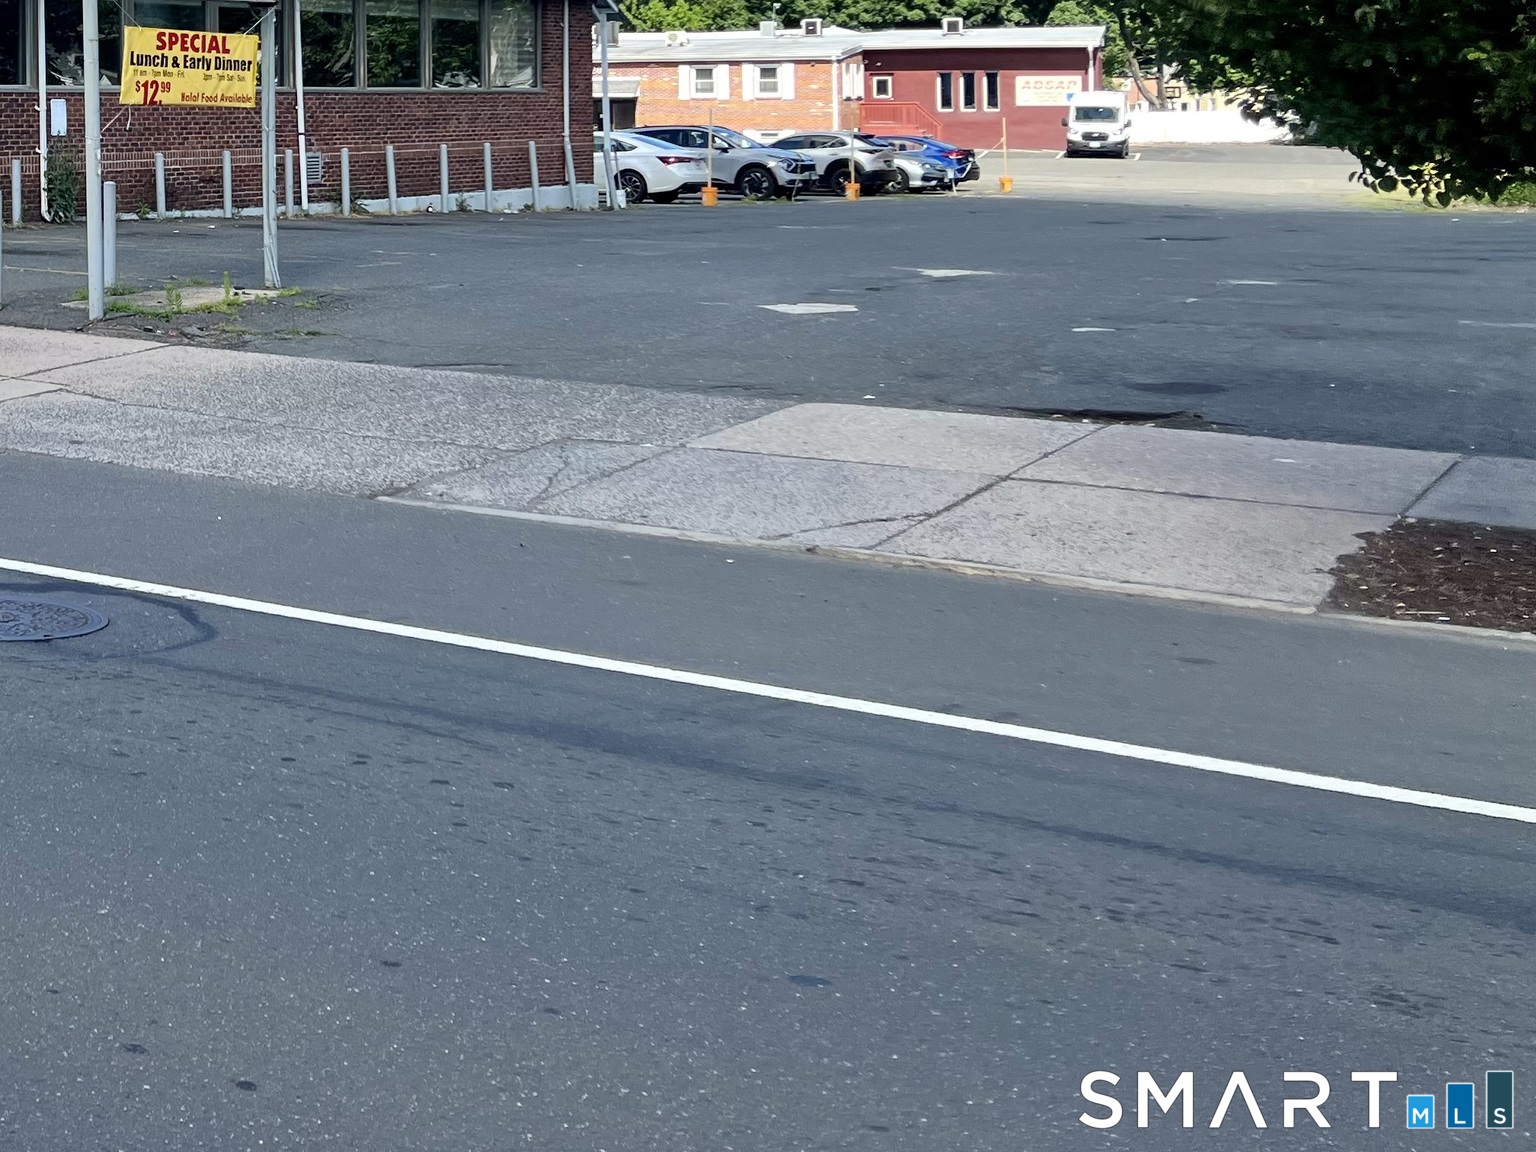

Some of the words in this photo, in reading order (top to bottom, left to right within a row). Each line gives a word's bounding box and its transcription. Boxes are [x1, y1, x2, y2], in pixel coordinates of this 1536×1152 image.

[156, 31, 231, 54] SPECIAL
[130, 51, 169, 68] Lunch
[171, 55, 180, 68] &
[183, 55, 212, 71] Early
[214, 56, 252, 71] Dinner
[201, 93, 220, 103] Food
[220, 93, 252, 104] Available
